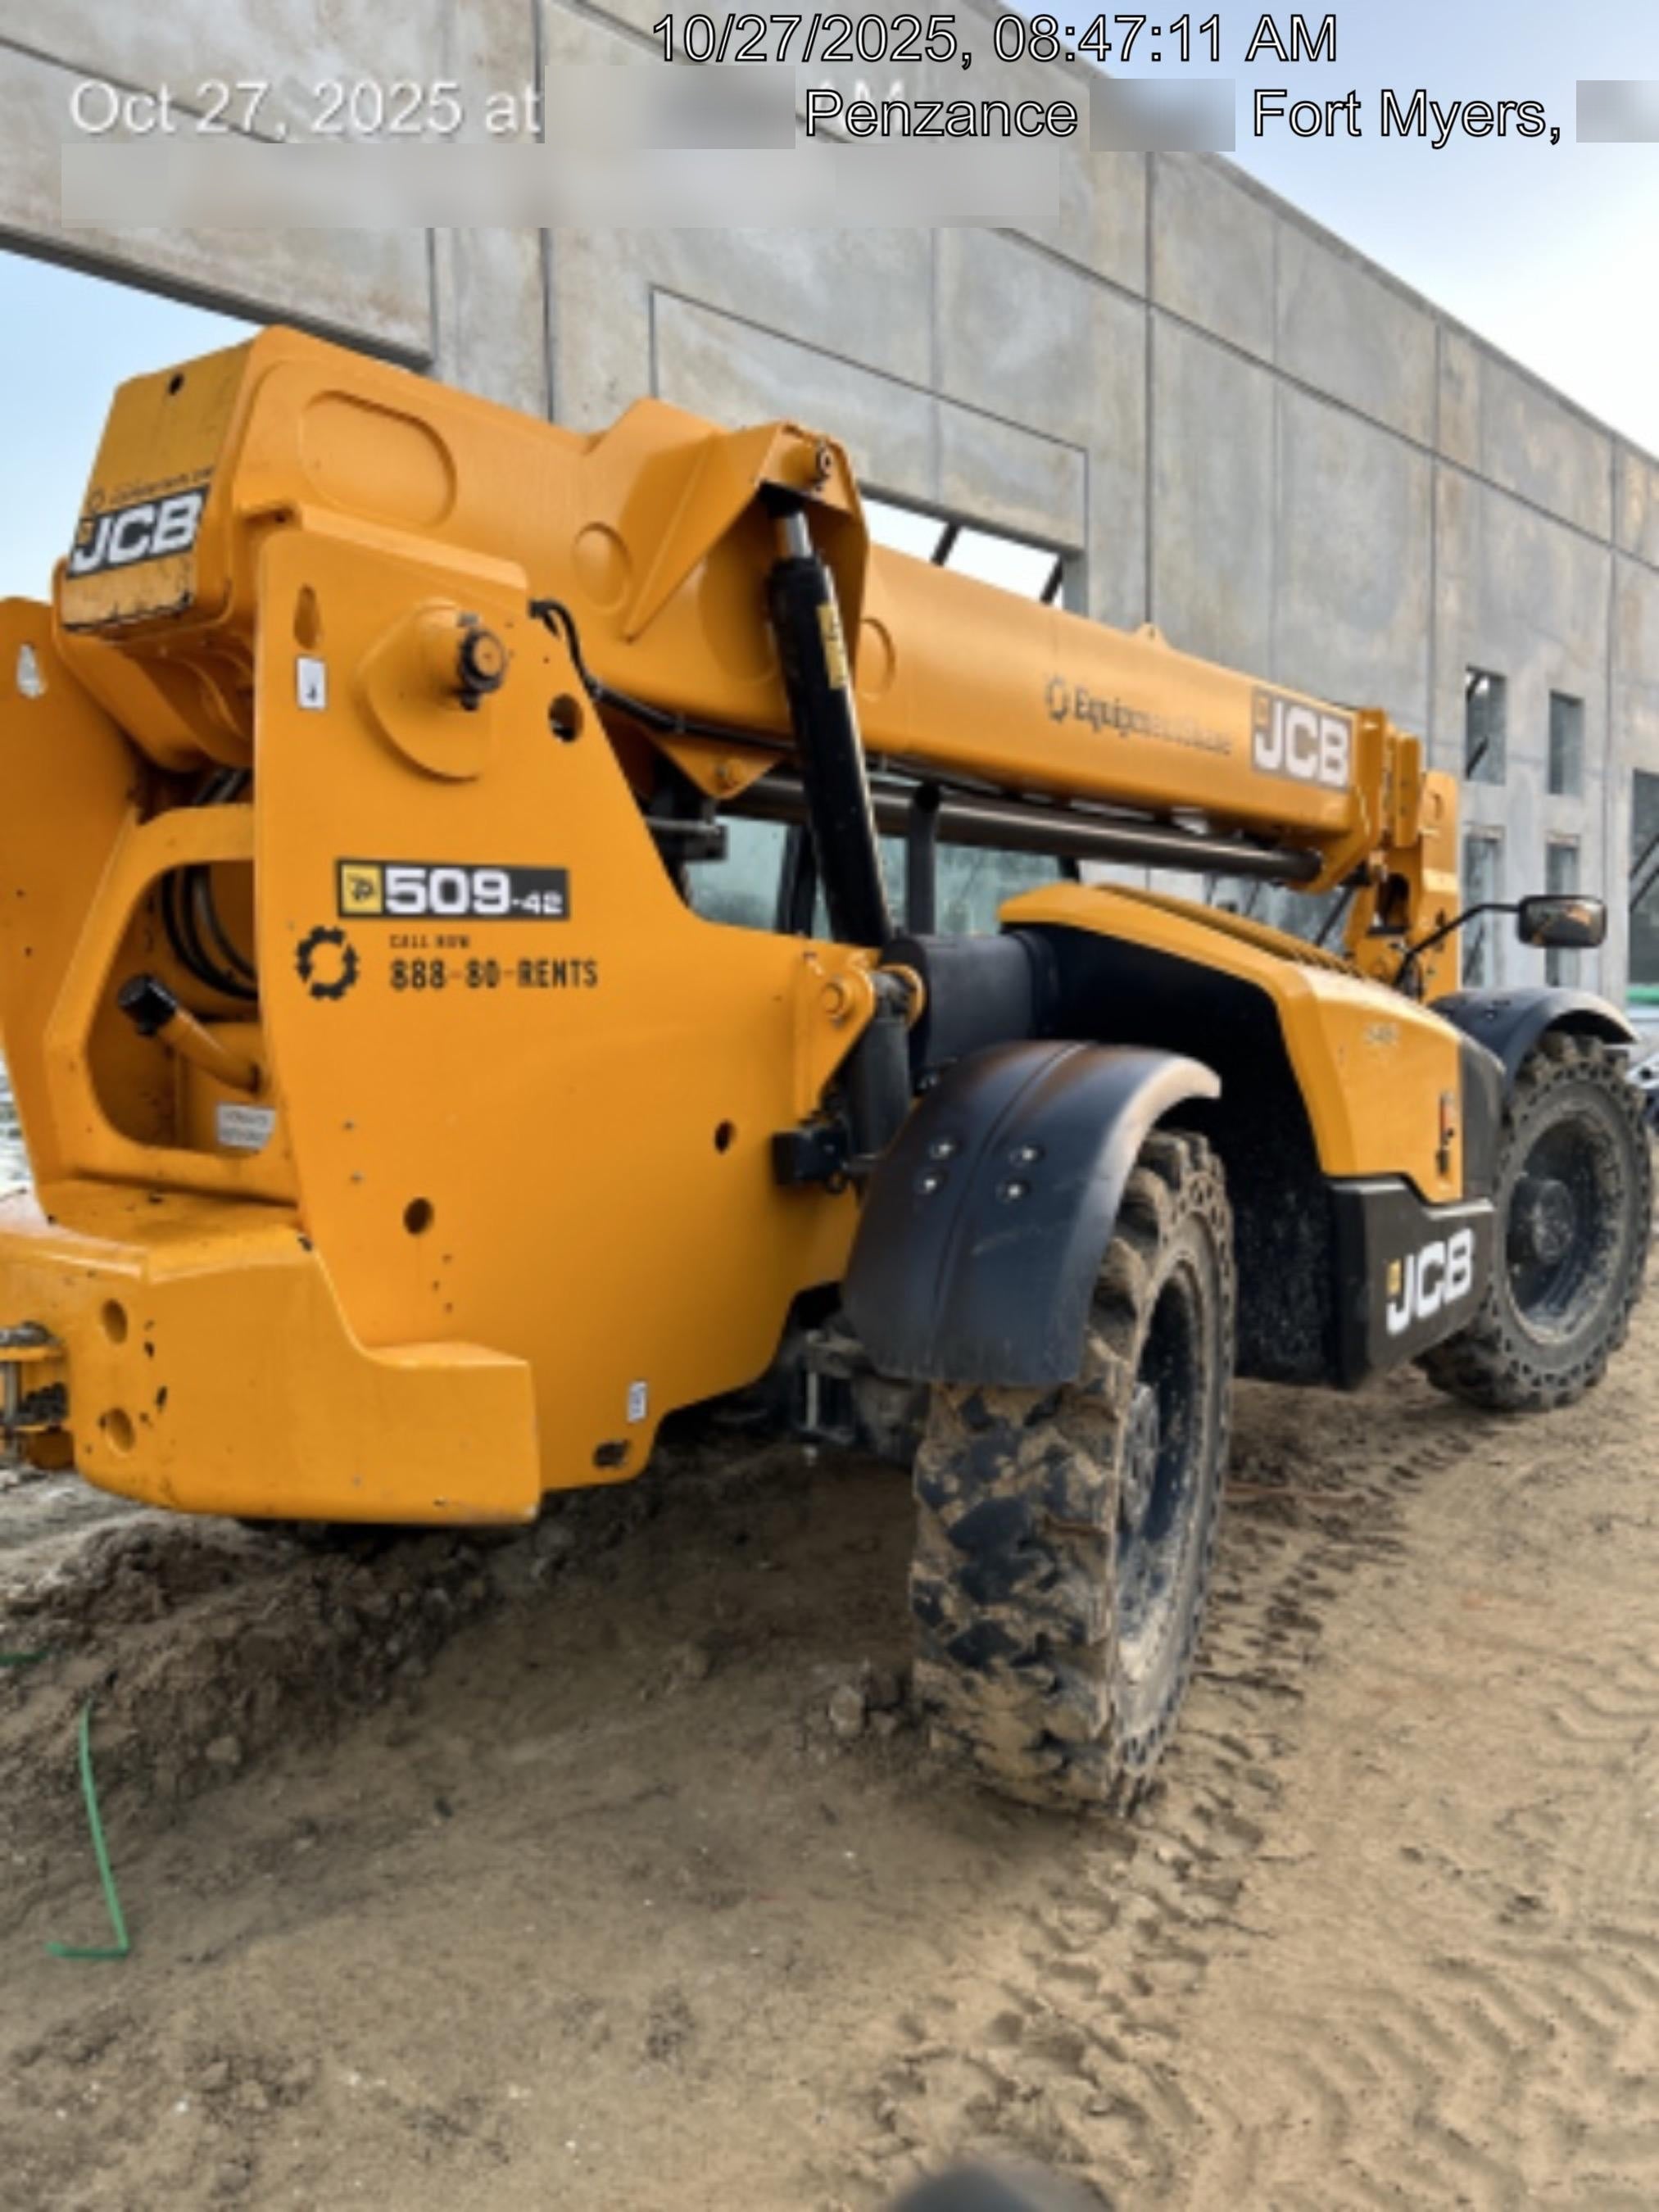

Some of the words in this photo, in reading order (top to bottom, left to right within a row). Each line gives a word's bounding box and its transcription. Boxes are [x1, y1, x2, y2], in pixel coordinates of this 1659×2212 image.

[70, 490, 203, 573] JCB
[1254, 698, 1349, 788] JCB
[384, 866, 564, 915] 509-42
[1386, 1227, 1474, 1335] JCB
